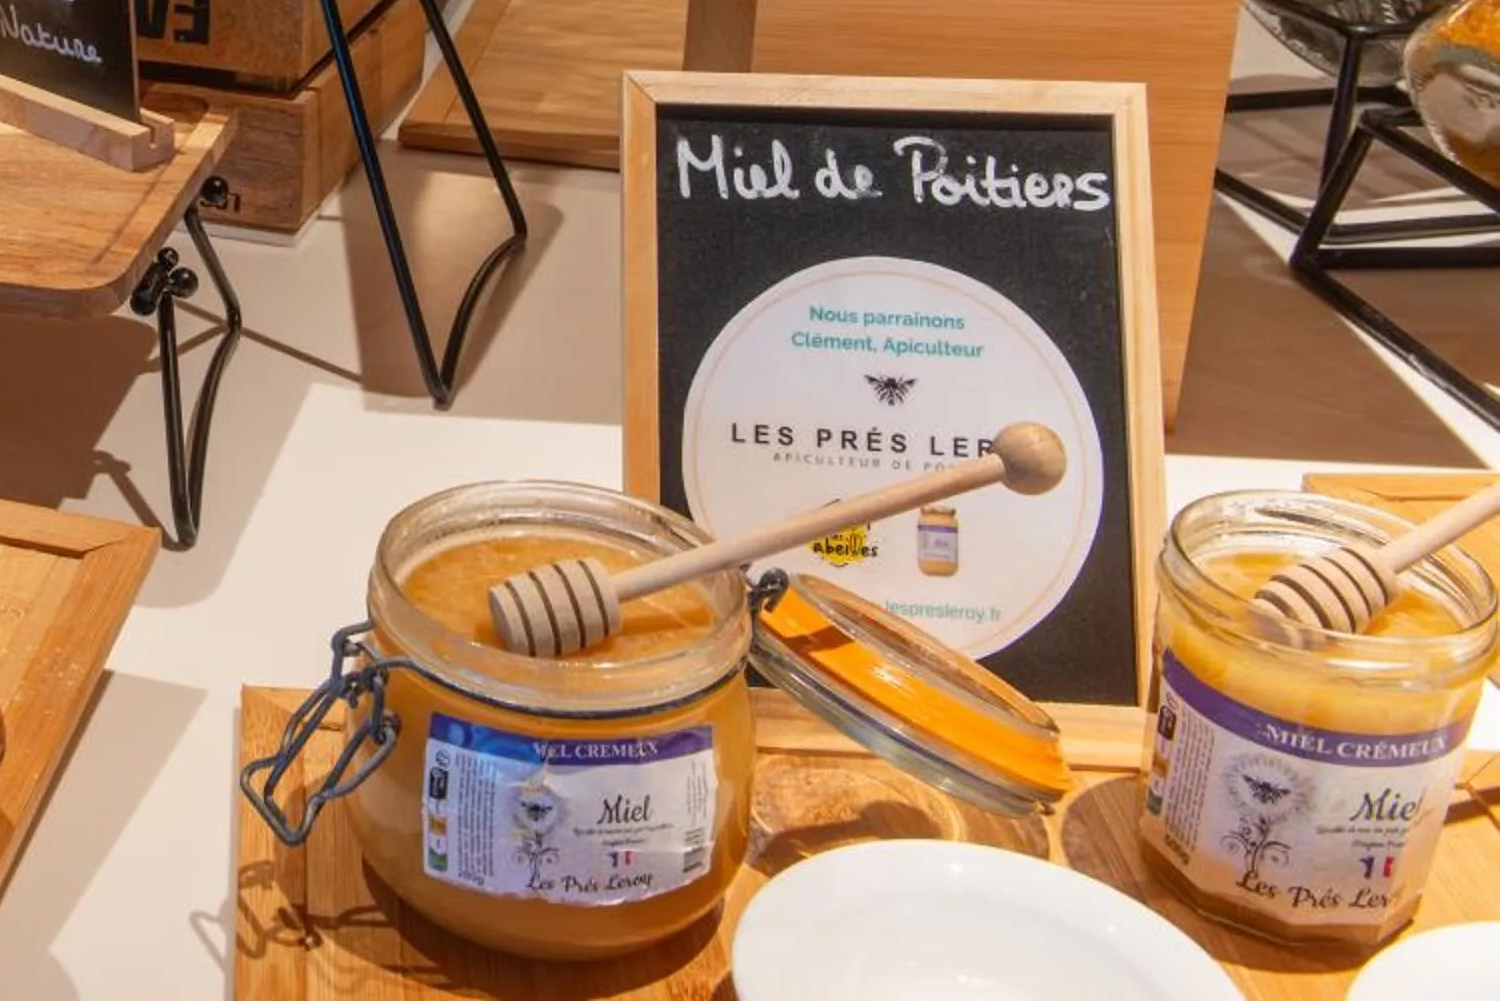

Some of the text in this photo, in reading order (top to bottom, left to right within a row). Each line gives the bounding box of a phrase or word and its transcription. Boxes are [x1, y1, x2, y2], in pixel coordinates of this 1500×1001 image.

[675, 135, 1111, 211] Miel de Poitiers
[809, 305, 965, 330] Nous parrainons
[883, 336, 985, 358] Apiculteur
[731, 422, 995, 459] LES PRÉS LER
[597, 794, 650, 825] Miel
